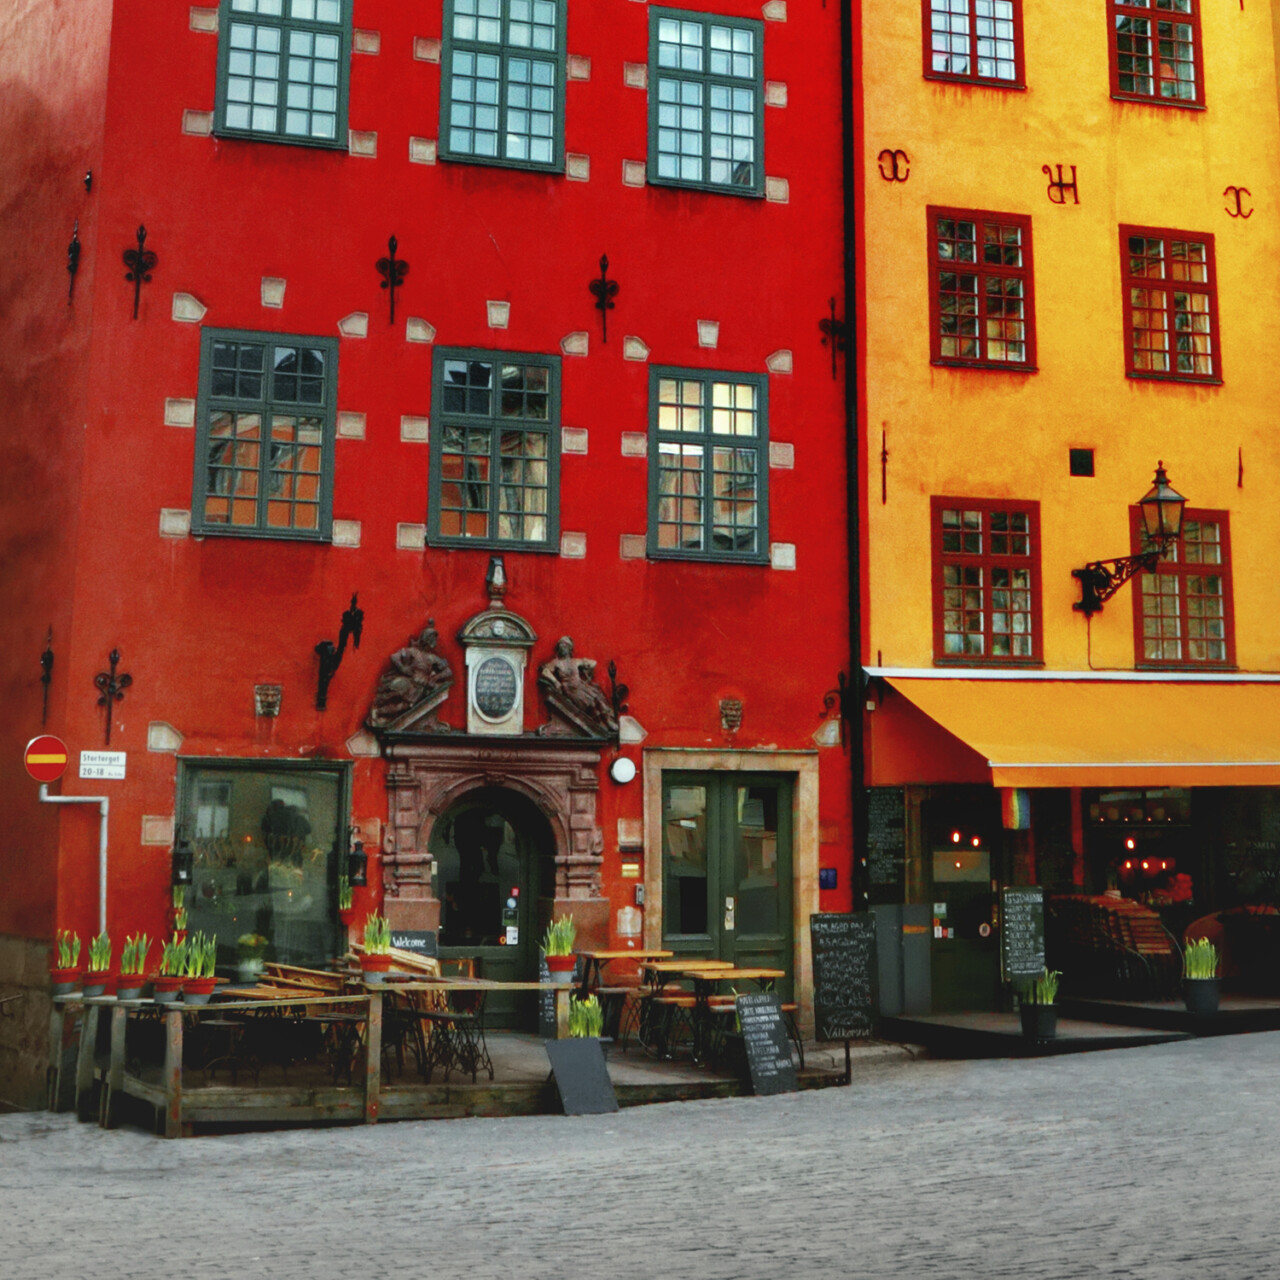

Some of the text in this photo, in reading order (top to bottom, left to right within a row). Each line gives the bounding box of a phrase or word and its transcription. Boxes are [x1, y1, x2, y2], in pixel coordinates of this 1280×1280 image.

[82, 753, 120, 765] Stortorget
[82, 767, 105, 776] 20-18
[392, 936, 426, 948] Welcome
